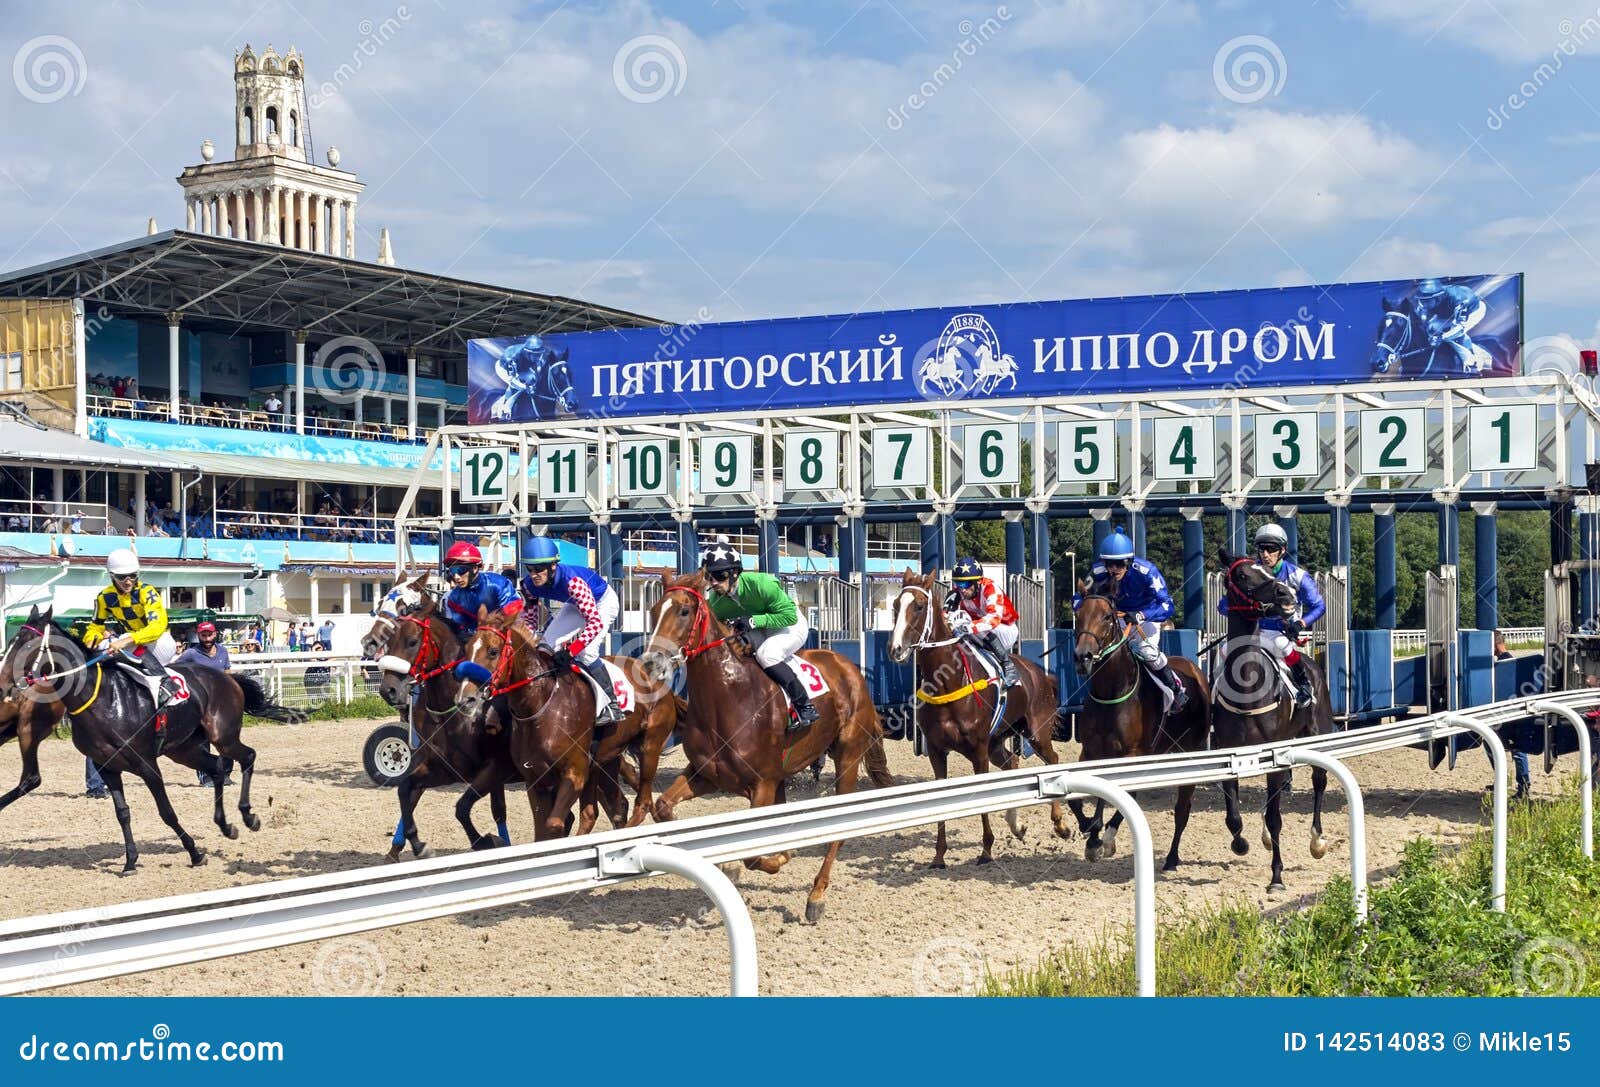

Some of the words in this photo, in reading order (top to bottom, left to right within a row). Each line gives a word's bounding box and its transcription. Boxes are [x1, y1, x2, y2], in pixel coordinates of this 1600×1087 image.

[957, 316, 980, 329] 1885
[590, 333, 904, 398] ПЯТИГОРСКИЙ
[1032, 322, 1336, 375] ИППОДРОМ
[888, 434, 913, 480] 7
[979, 429, 1004, 478] 6
[1074, 426, 1100, 475] 5
[1169, 425, 1197, 475] 4
[1272, 419, 1301, 471] 3
[1379, 415, 1407, 468] 2
[1491, 411, 1510, 463] 1
[465, 452, 504, 496] 12
[547, 449, 576, 494] 11
[623, 445, 662, 490] 10
[714, 442, 737, 487] 9
[800, 438, 823, 485] 8
[613, 680, 628, 709] 5
[800, 663, 823, 692] 3
